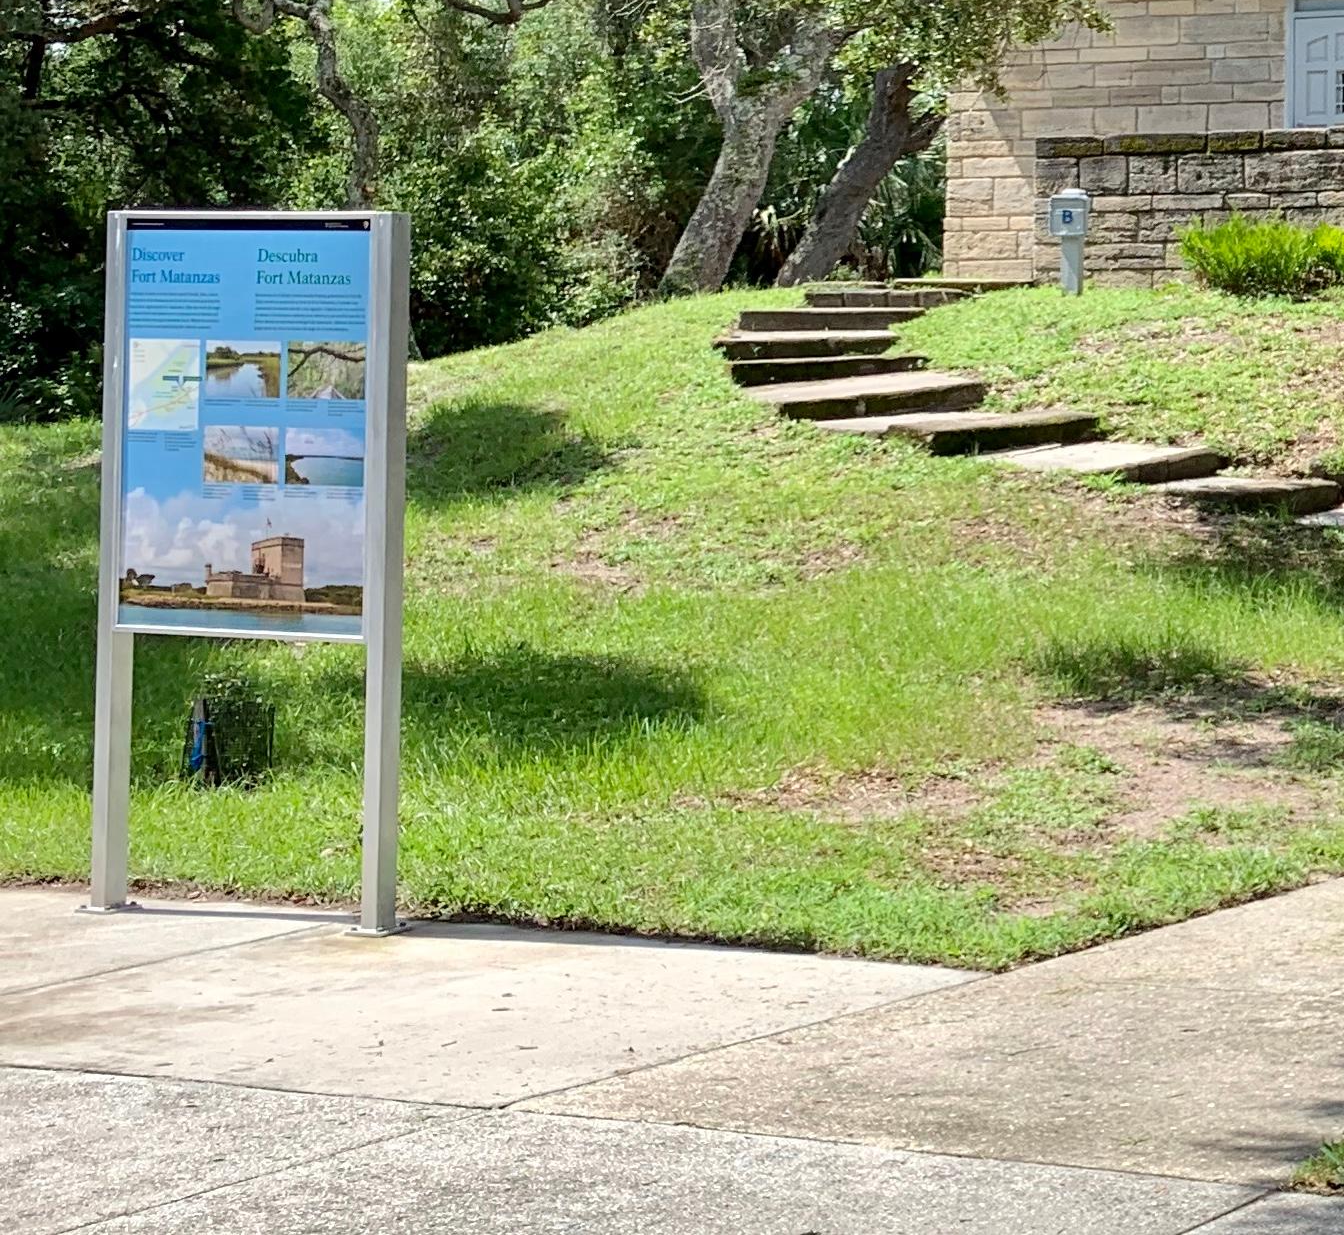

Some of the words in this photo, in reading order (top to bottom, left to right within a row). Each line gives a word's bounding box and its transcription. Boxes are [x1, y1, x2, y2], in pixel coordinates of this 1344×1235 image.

[1062, 210, 1073, 224] B
[131, 247, 185, 262] Discover
[257, 248, 318, 263] Descubra
[131, 269, 157, 283] Fort
[160, 270, 221, 284] Matanzas
[256, 270, 283, 285] Fort
[287, 271, 351, 285] Matanzas
